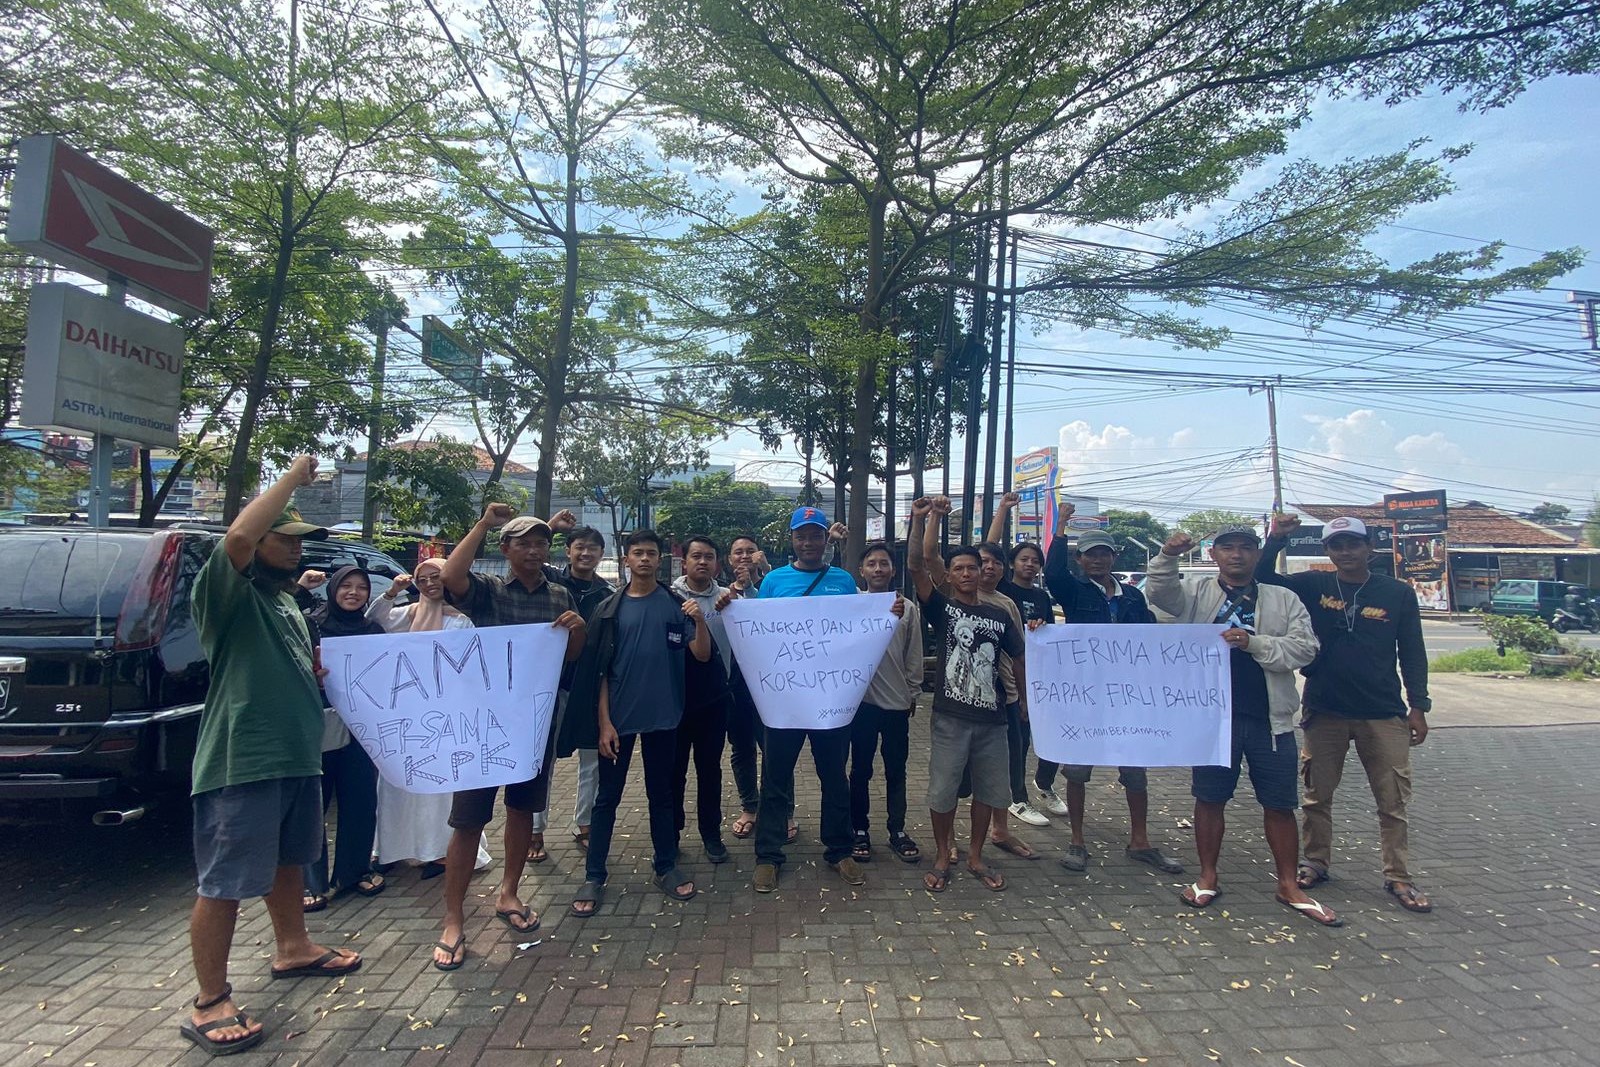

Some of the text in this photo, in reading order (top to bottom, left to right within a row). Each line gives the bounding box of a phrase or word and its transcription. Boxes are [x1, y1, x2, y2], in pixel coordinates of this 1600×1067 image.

[65, 320, 180, 375] DAIHATSU
[62, 399, 106, 418] ASTRA
[1290, 536, 1323, 546] grafika
[734, 618, 893, 638] TANGKAP DAN SITA
[773, 640, 832, 666] ASET
[1047, 637, 1222, 667] TERIMA KASIH
[344, 633, 513, 712] KAMI
[1031, 680, 1226, 711] BAPAK FIRLI BAHURI
[351, 708, 509, 760] BERSAMA
[403, 742, 517, 786] KPK
